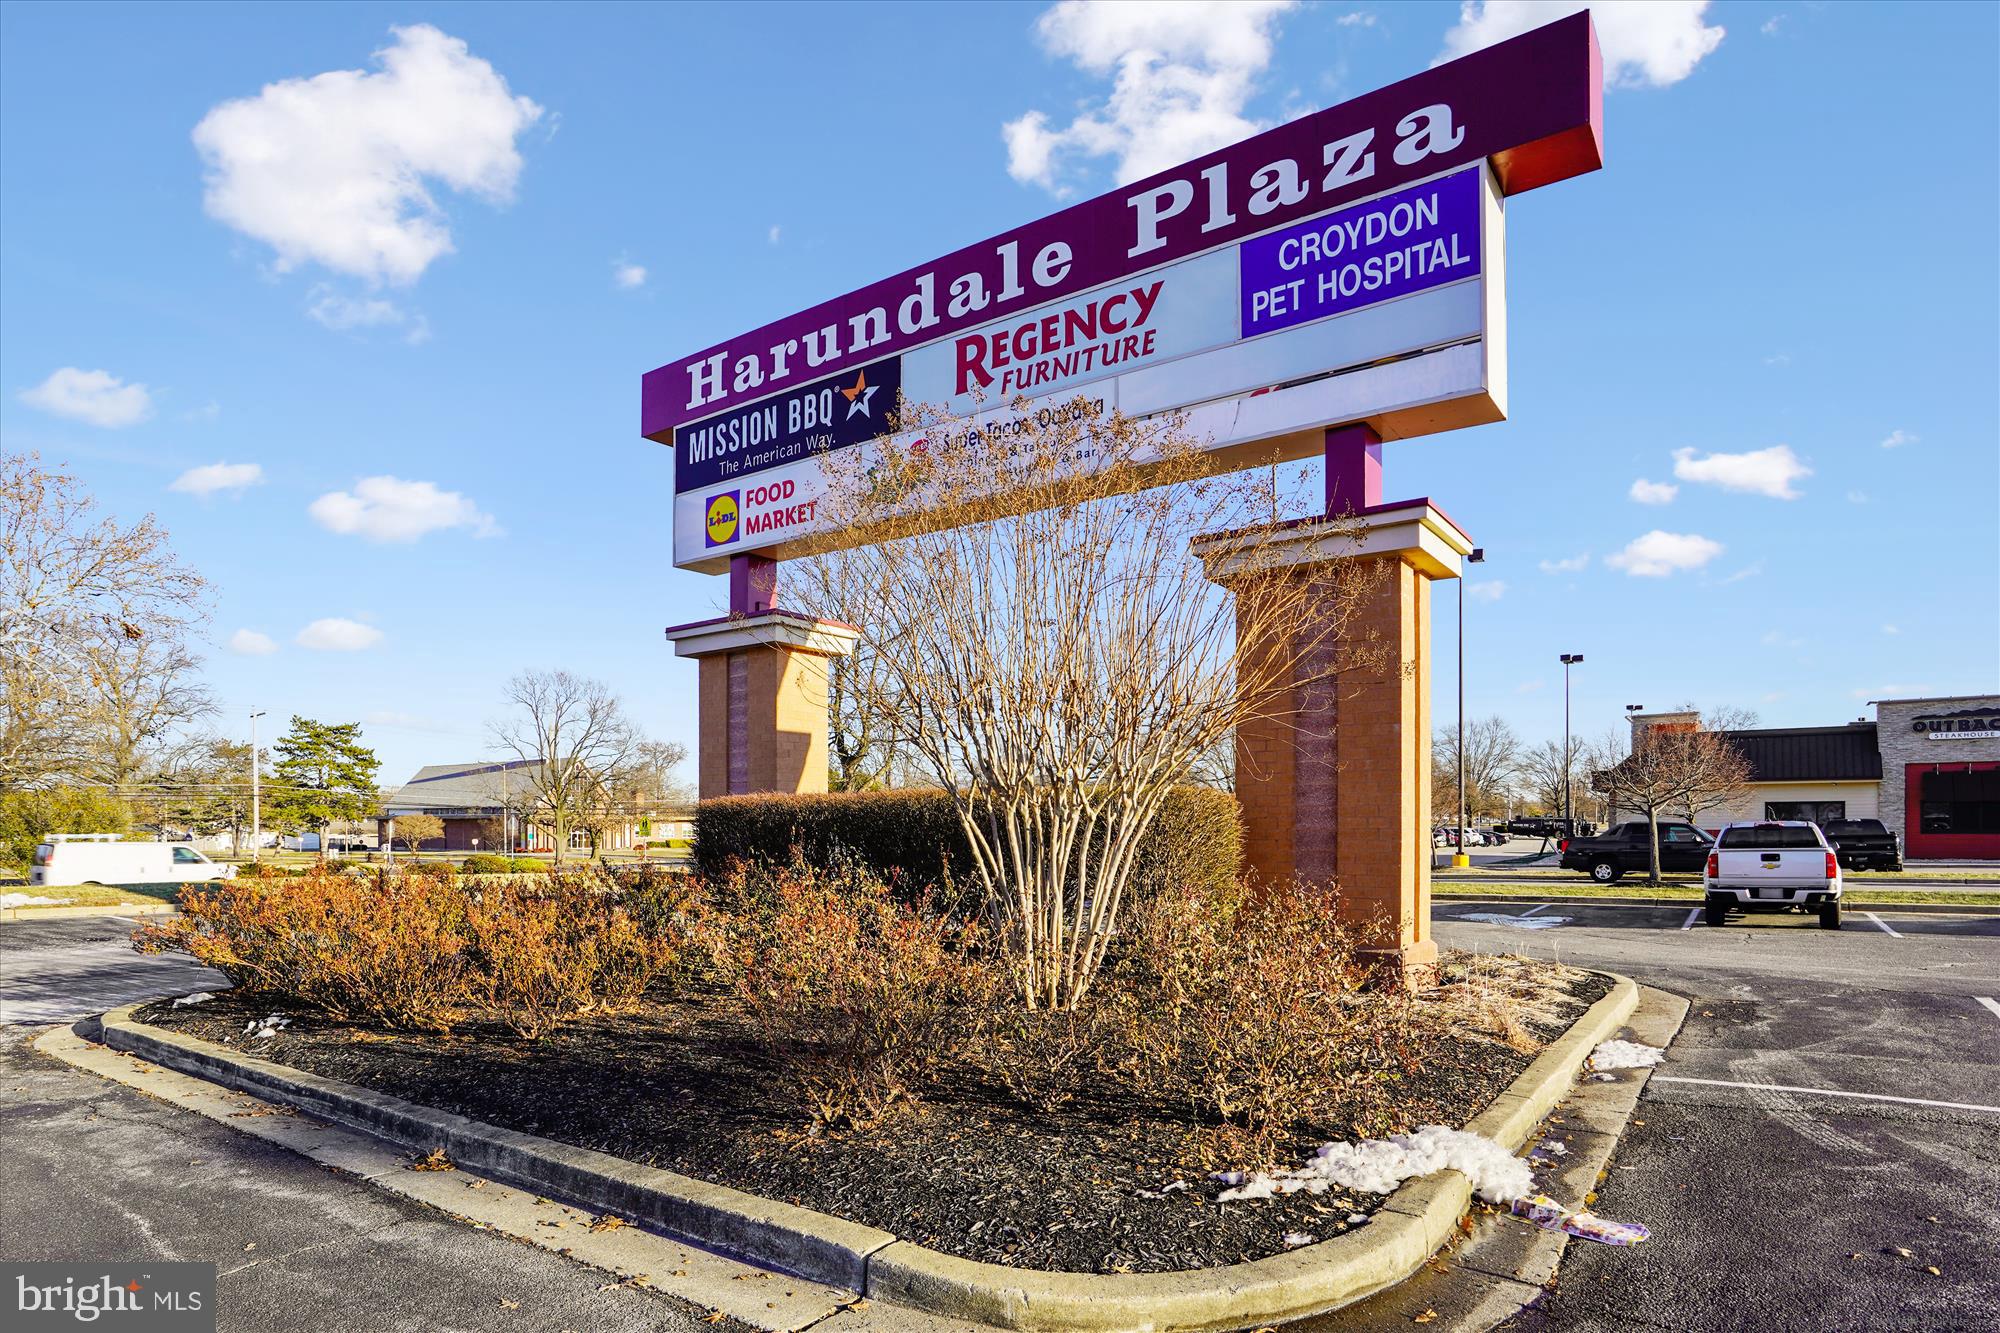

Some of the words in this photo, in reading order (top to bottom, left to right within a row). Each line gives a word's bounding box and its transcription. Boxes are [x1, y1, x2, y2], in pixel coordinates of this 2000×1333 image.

[685, 241, 1074, 411] Harundale
[1127, 103, 1465, 258] Plaza
[1278, 194, 1439, 271] CROYDON
[1252, 279, 1305, 322] PET
[1318, 234, 1471, 305] HOSPITAL
[955, 280, 1165, 396] REGENCY
[1001, 328, 1157, 395] FURNITURE
[689, 405, 777, 465] MISSION
[719, 459, 739, 476] The
[743, 442, 801, 469] American
[745, 479, 796, 509] FOOD
[745, 501, 818, 536] MARKET
[1934, 731, 1996, 739] STEAKHOUSE
